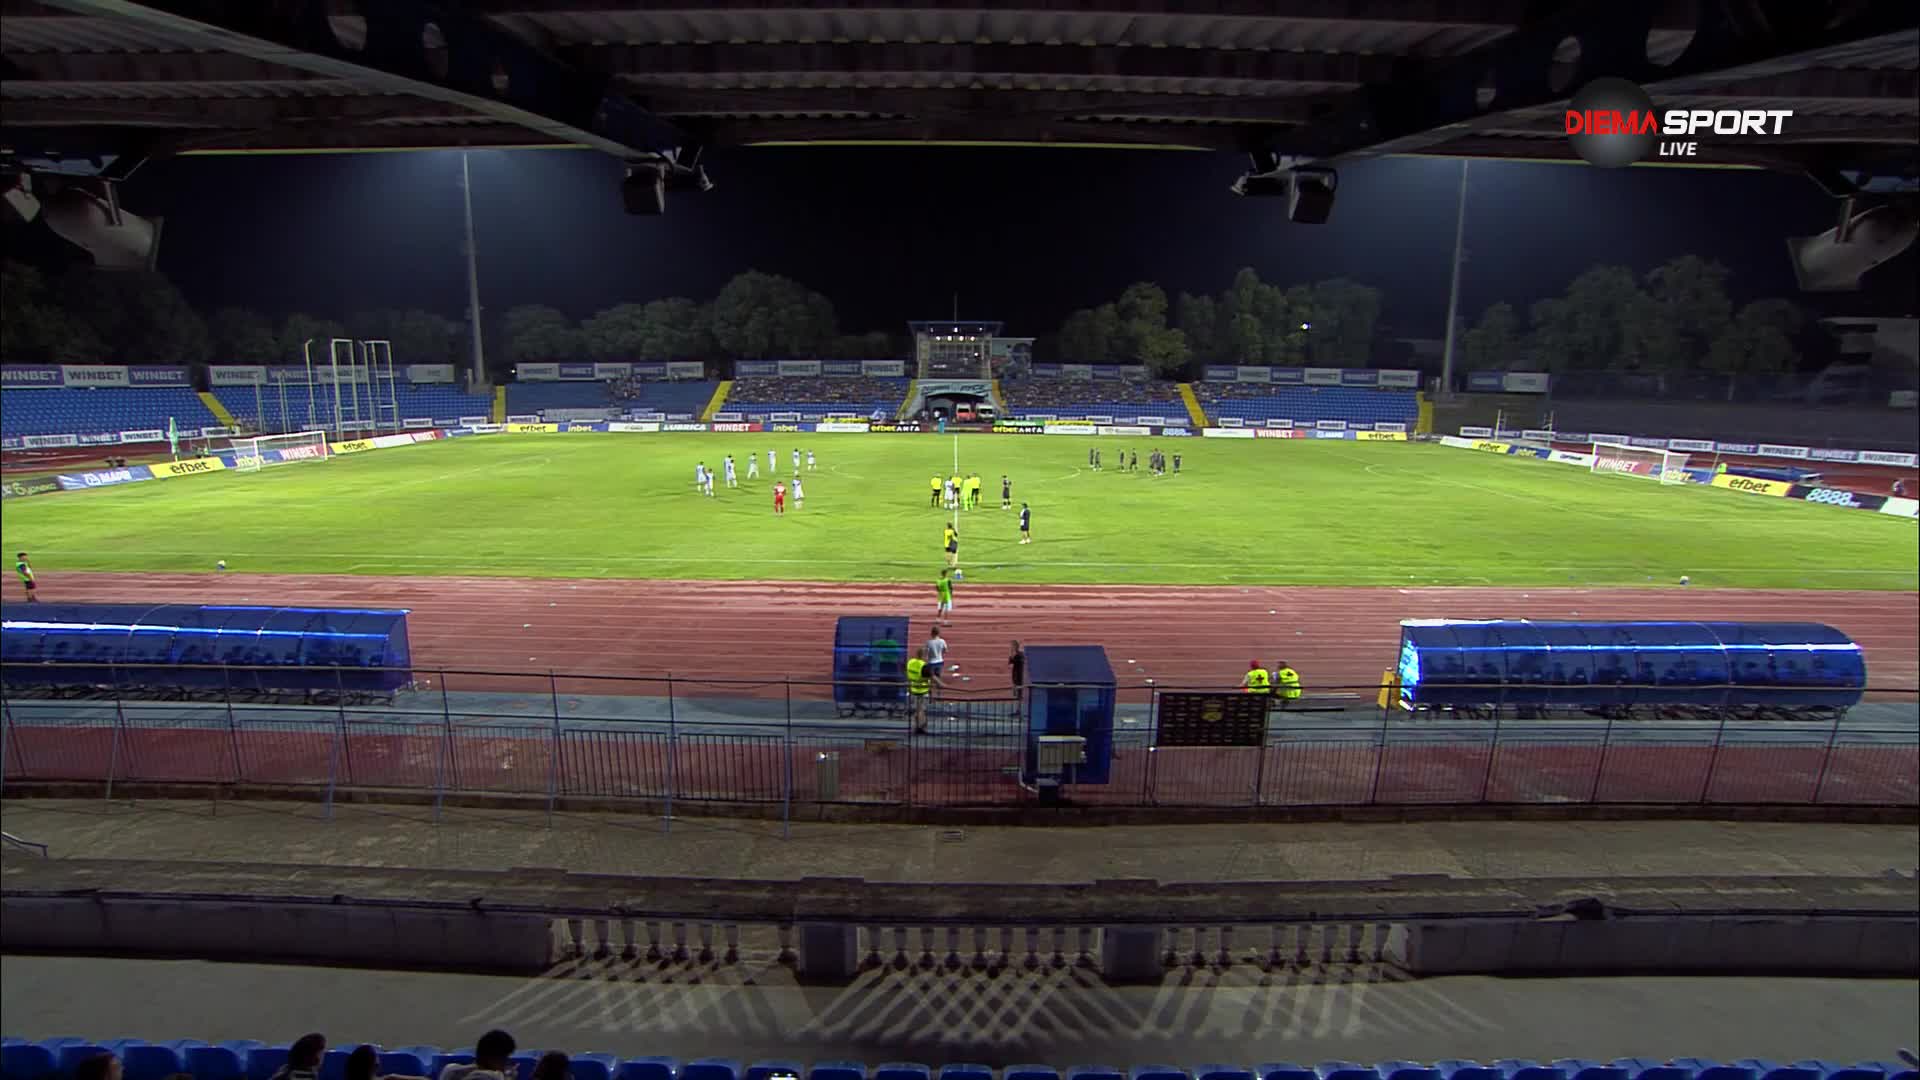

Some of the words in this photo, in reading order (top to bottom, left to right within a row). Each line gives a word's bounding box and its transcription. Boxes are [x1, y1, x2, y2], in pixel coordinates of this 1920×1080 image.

[2, 370, 58, 381] WINBET
[68, 369, 123, 380] WINBET
[132, 370, 184, 381] WINBET
[520, 424, 547, 432] efbet
[714, 423, 751, 432] WINBET
[773, 423, 798, 432] inbet
[80, 433, 119, 443] WINBET
[124, 431, 160, 440] WINBET
[1256, 429, 1294, 438] WINBET
[29, 436, 73, 446] WINBET
[282, 445, 319, 460] WINBET
[170, 461, 210, 474] efbet
[1598, 457, 1639, 472] WINBET
[1728, 479, 1771, 493] efbet
[1806, 488, 1853, 506] 8888
